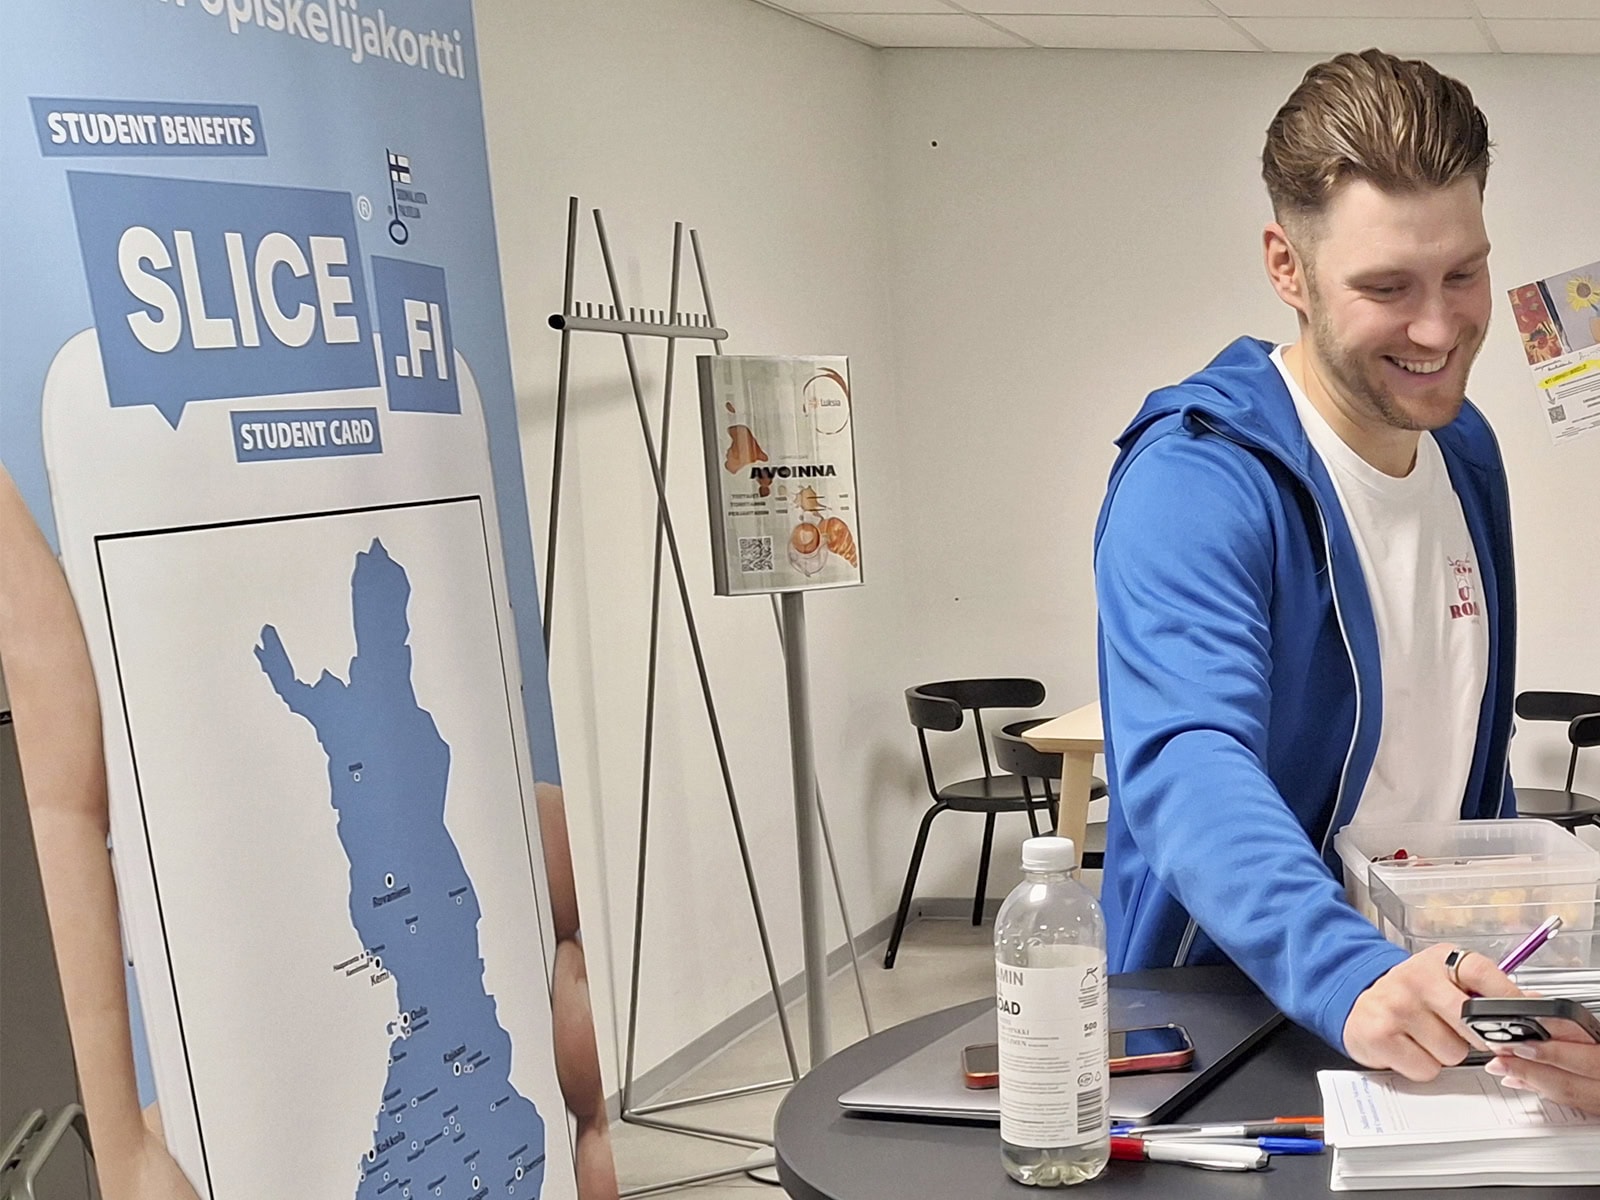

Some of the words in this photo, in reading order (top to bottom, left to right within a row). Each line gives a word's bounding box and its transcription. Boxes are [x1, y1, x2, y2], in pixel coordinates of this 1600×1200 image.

[48, 112, 157, 144] STUDENT
[160, 116, 256, 145] BENEFITS
[117, 226, 361, 353] SLICE
[395, 298, 449, 380] .FI
[240, 422, 327, 450] STUDENT
[330, 419, 373, 446] CARD
[750, 465, 836, 479] AVOINNA
[370, 971, 389, 986] Kemi
